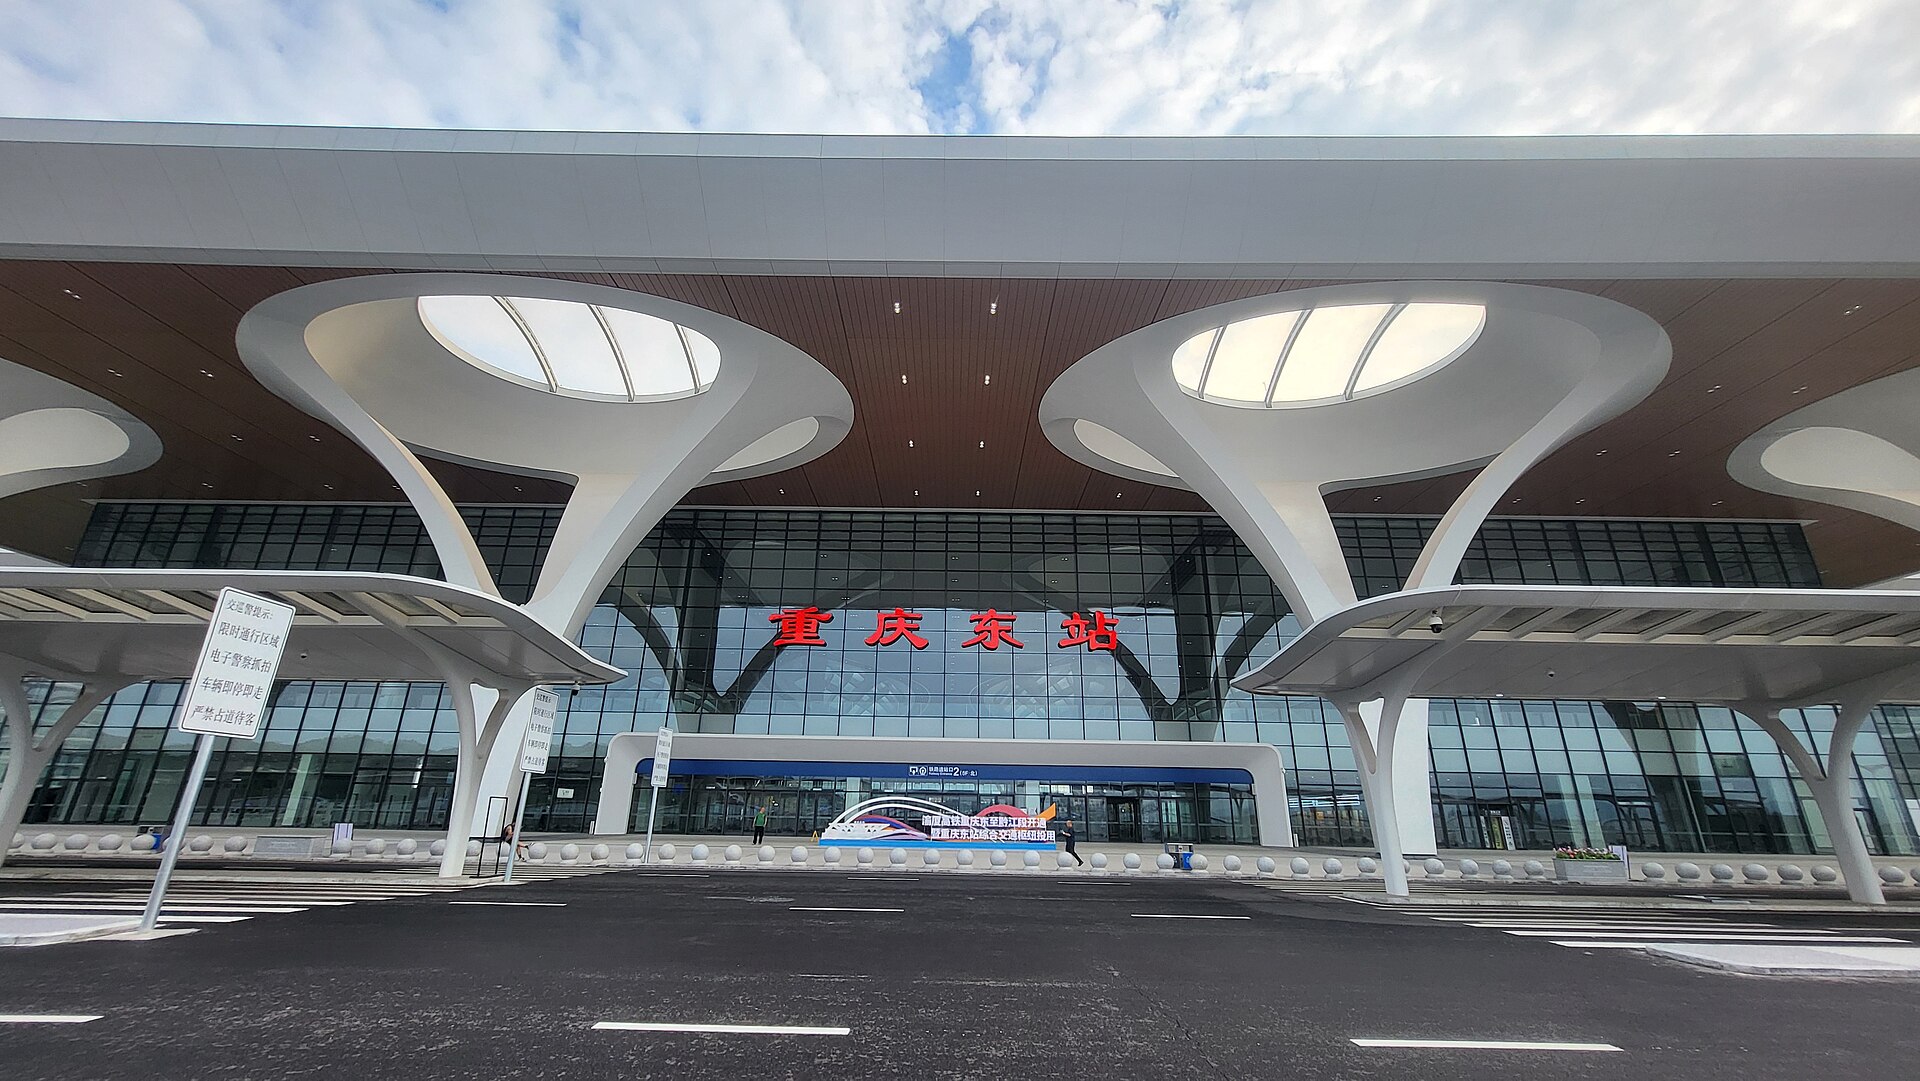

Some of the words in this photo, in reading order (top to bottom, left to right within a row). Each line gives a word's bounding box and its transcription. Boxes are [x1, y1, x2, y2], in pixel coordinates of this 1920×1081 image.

[218, 621, 280, 648] 限时通行区域
[768, 606, 1121, 653] 重庆东站
[211, 648, 272, 673] 电子警察抓拍
[200, 676, 264, 700] 车辆即停即走
[191, 705, 256, 726] 严禁占道待客
[953, 766, 960, 777] 2
